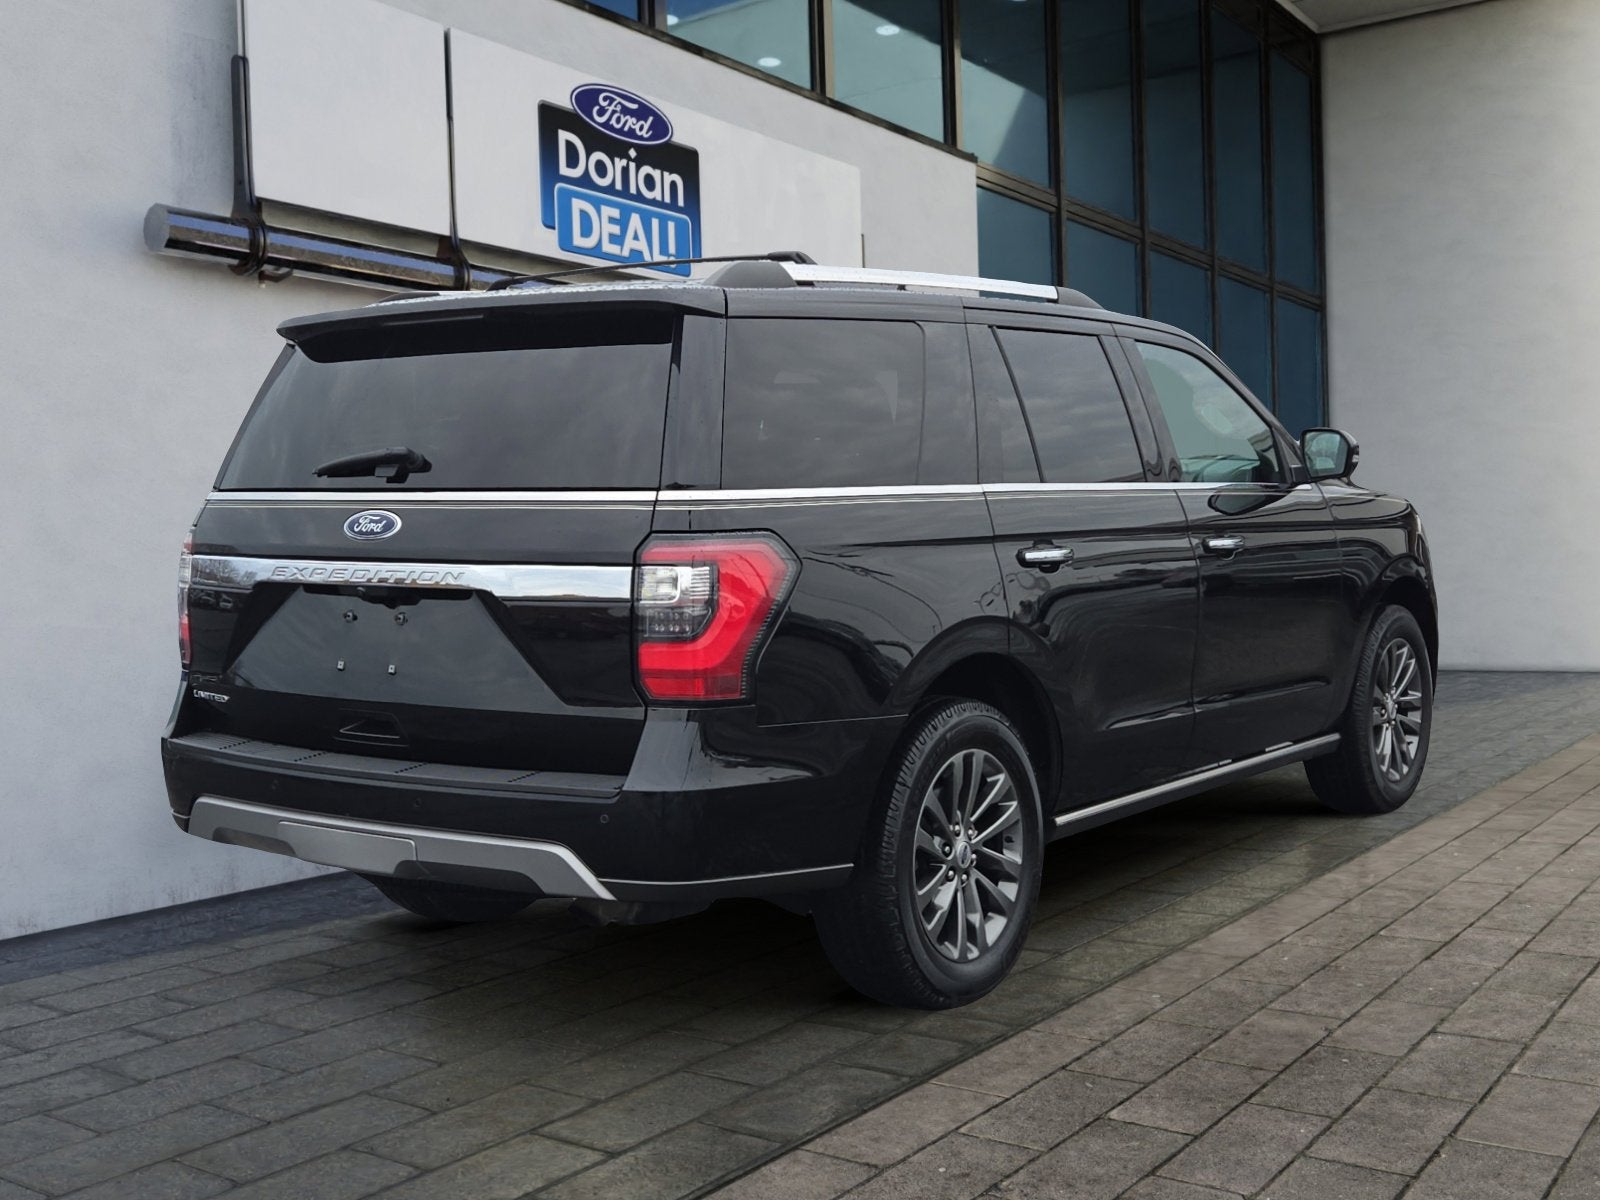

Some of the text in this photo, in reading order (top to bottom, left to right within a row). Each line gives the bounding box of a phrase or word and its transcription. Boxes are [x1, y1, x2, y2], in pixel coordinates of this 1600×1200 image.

[592, 92, 653, 138] Ford
[558, 129, 684, 207] Dorian
[571, 197, 677, 268] DEAL!
[353, 515, 387, 532] Ford
[270, 566, 466, 585] EXPEDITION
